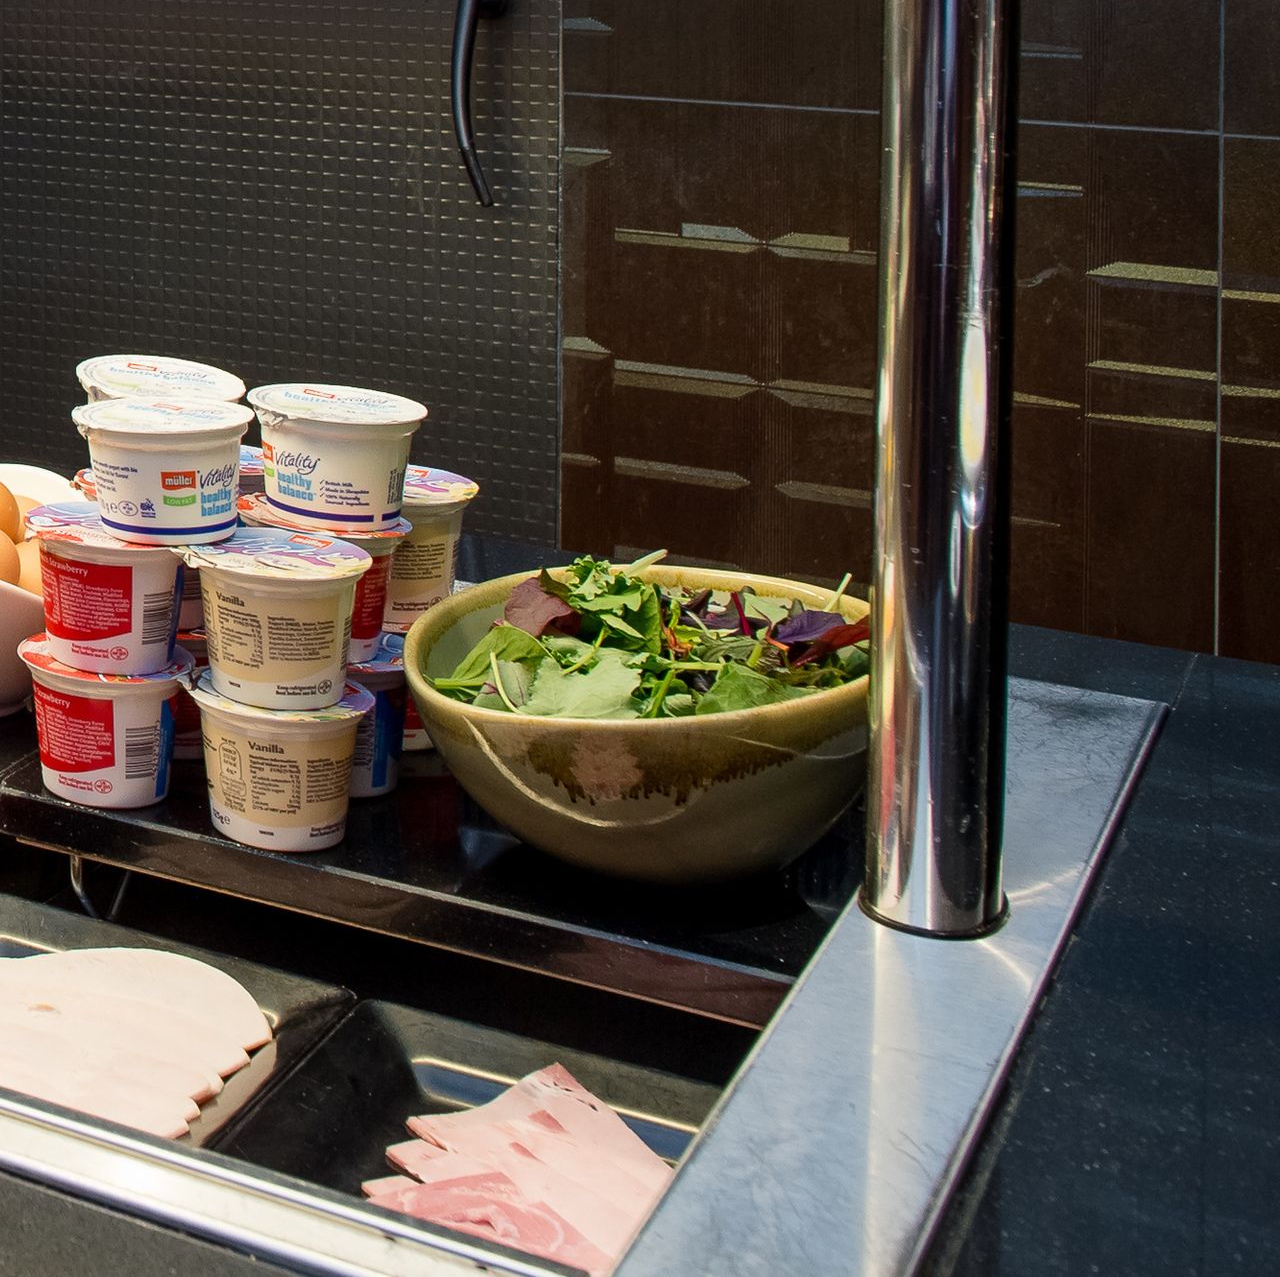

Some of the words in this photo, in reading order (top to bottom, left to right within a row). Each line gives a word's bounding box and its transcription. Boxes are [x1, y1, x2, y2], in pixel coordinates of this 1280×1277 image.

[276, 451, 318, 476] Vitality
[165, 475, 193, 487] müller
[200, 463, 237, 490] Vitality
[277, 470, 312, 491] healthy
[201, 487, 232, 503] healthy
[216, 591, 245, 607] Vanilla
[248, 740, 285, 755] Vanilla
